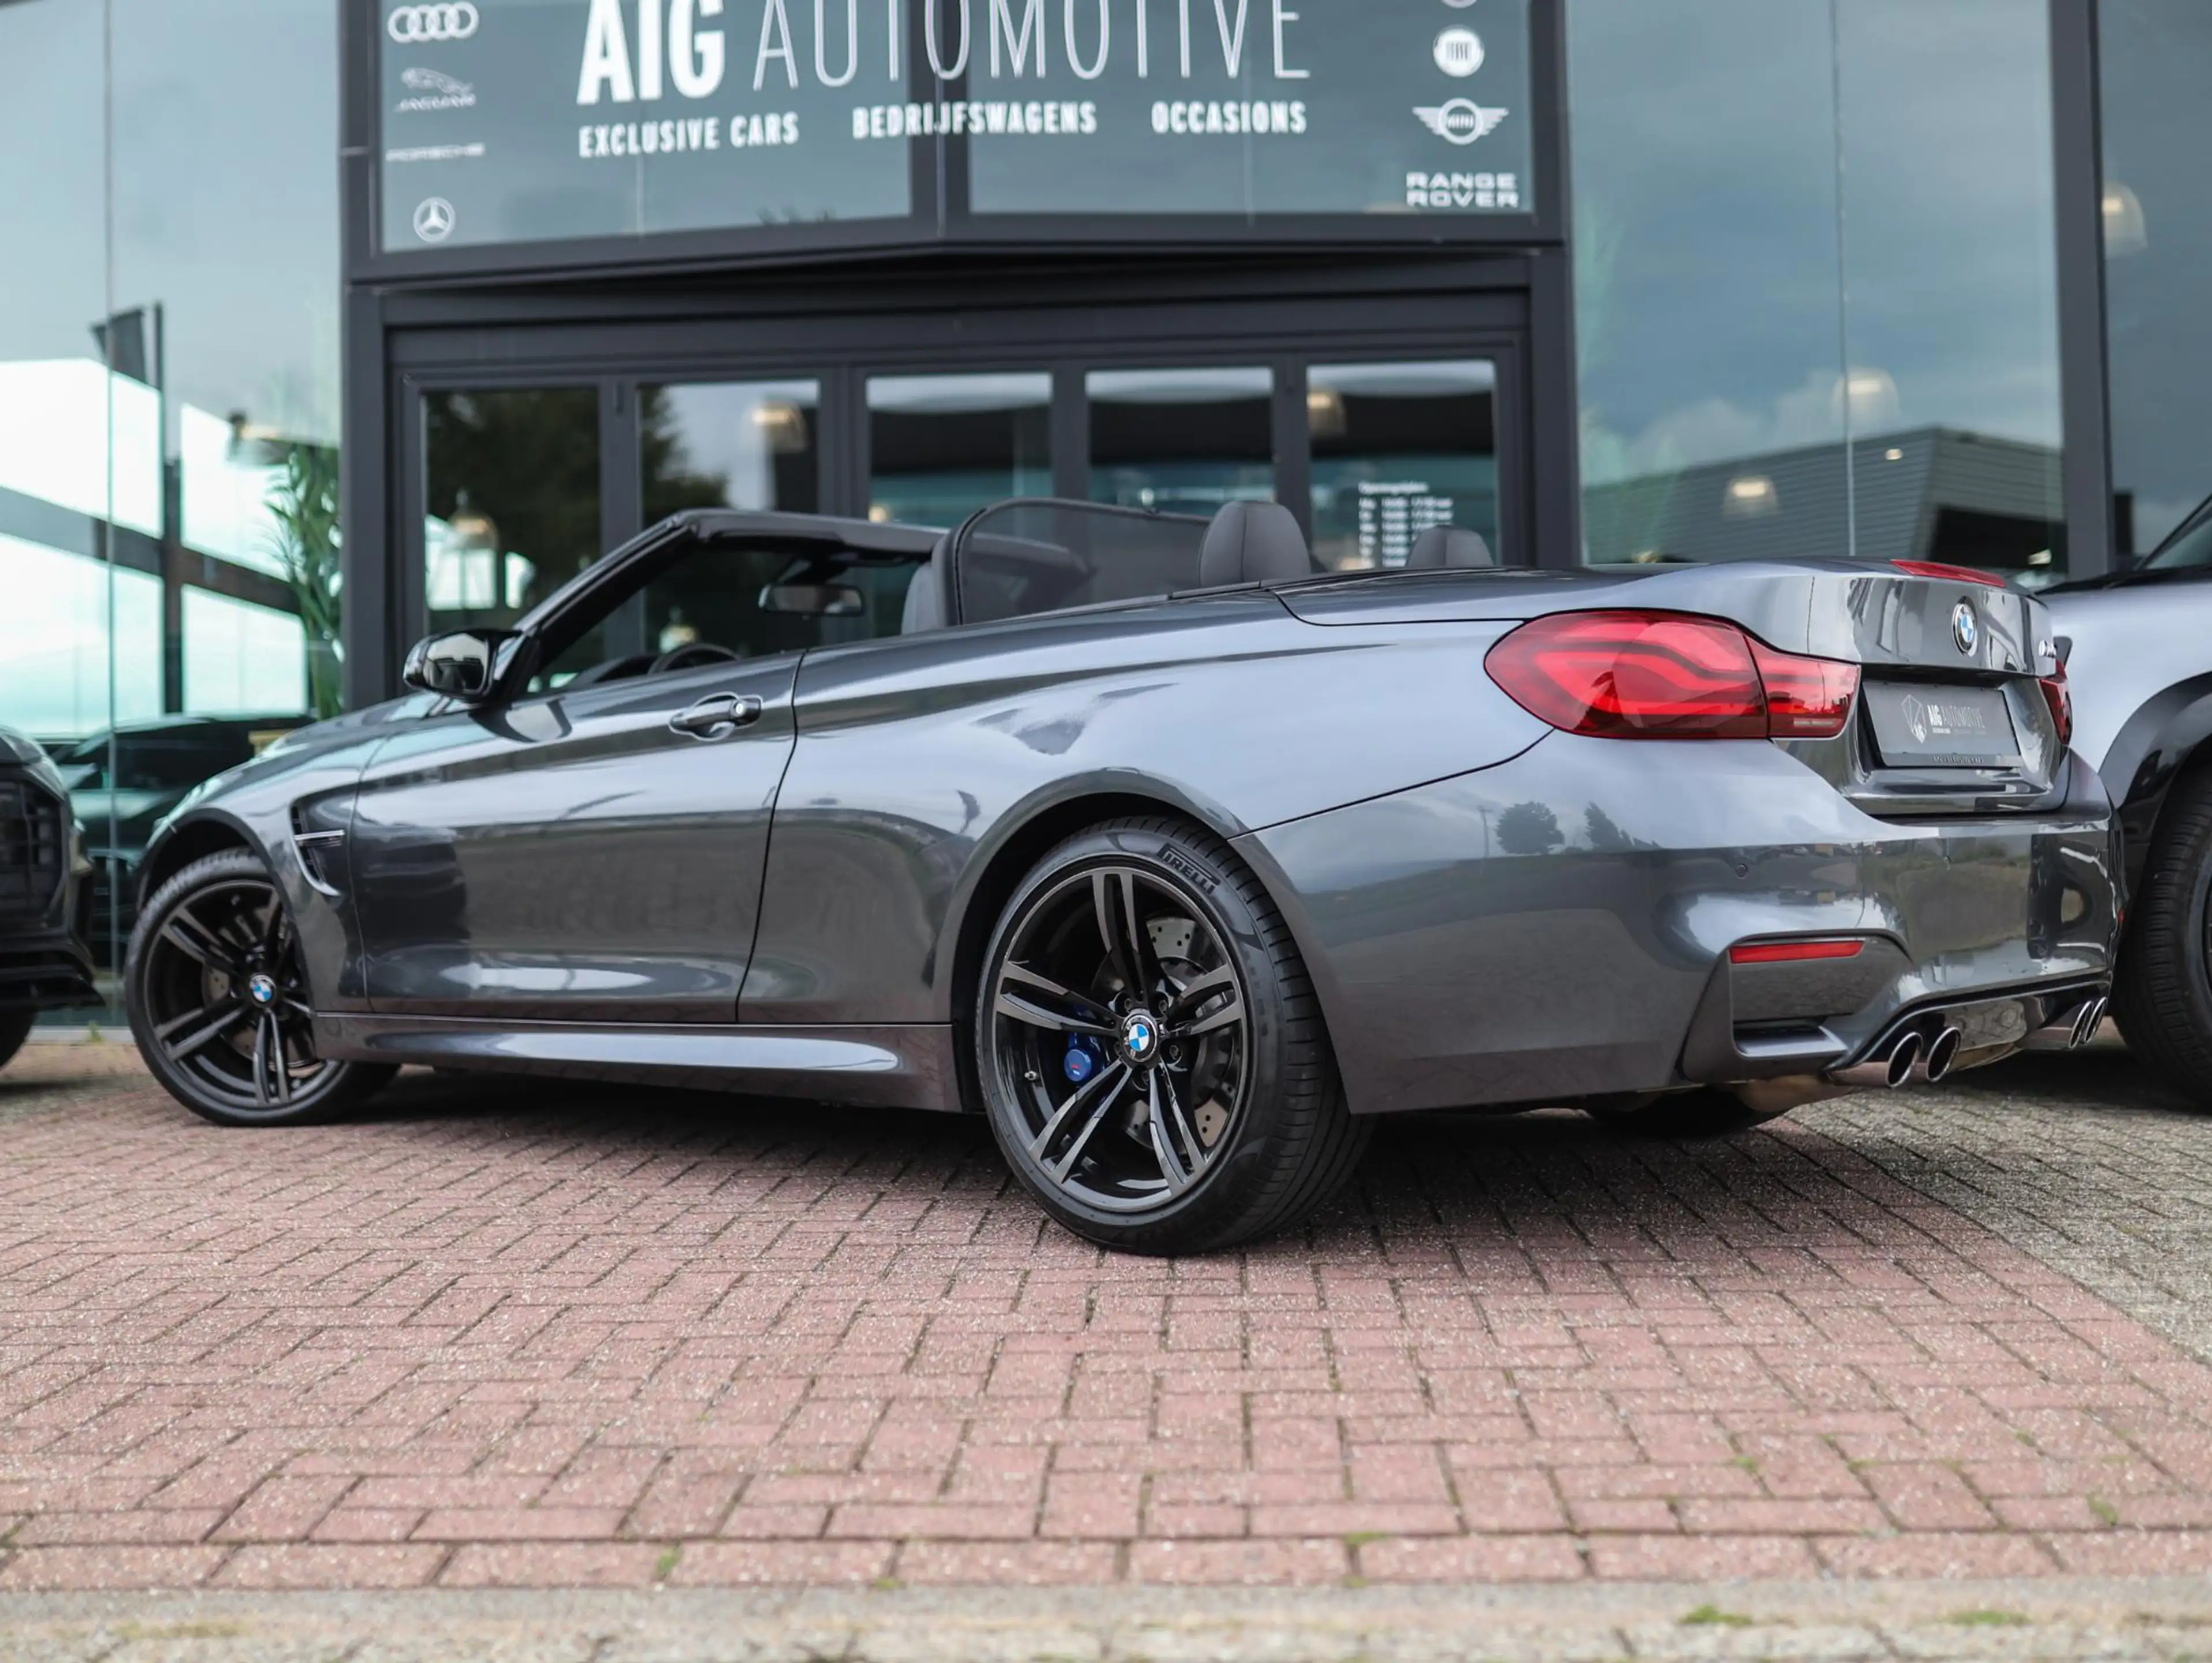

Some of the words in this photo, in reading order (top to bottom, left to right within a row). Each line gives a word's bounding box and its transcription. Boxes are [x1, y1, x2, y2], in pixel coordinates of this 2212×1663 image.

[576, 0, 725, 105] AIG
[579, 117, 721, 158] EXCLUSIVE
[730, 111, 799, 148] CARS
[852, 101, 1097, 139] BEDRIJFSWAGENS
[1150, 100, 1308, 134] OCCASIONS
[1406, 172, 1517, 189] RANGE
[1406, 191, 1519, 208] ROVER
